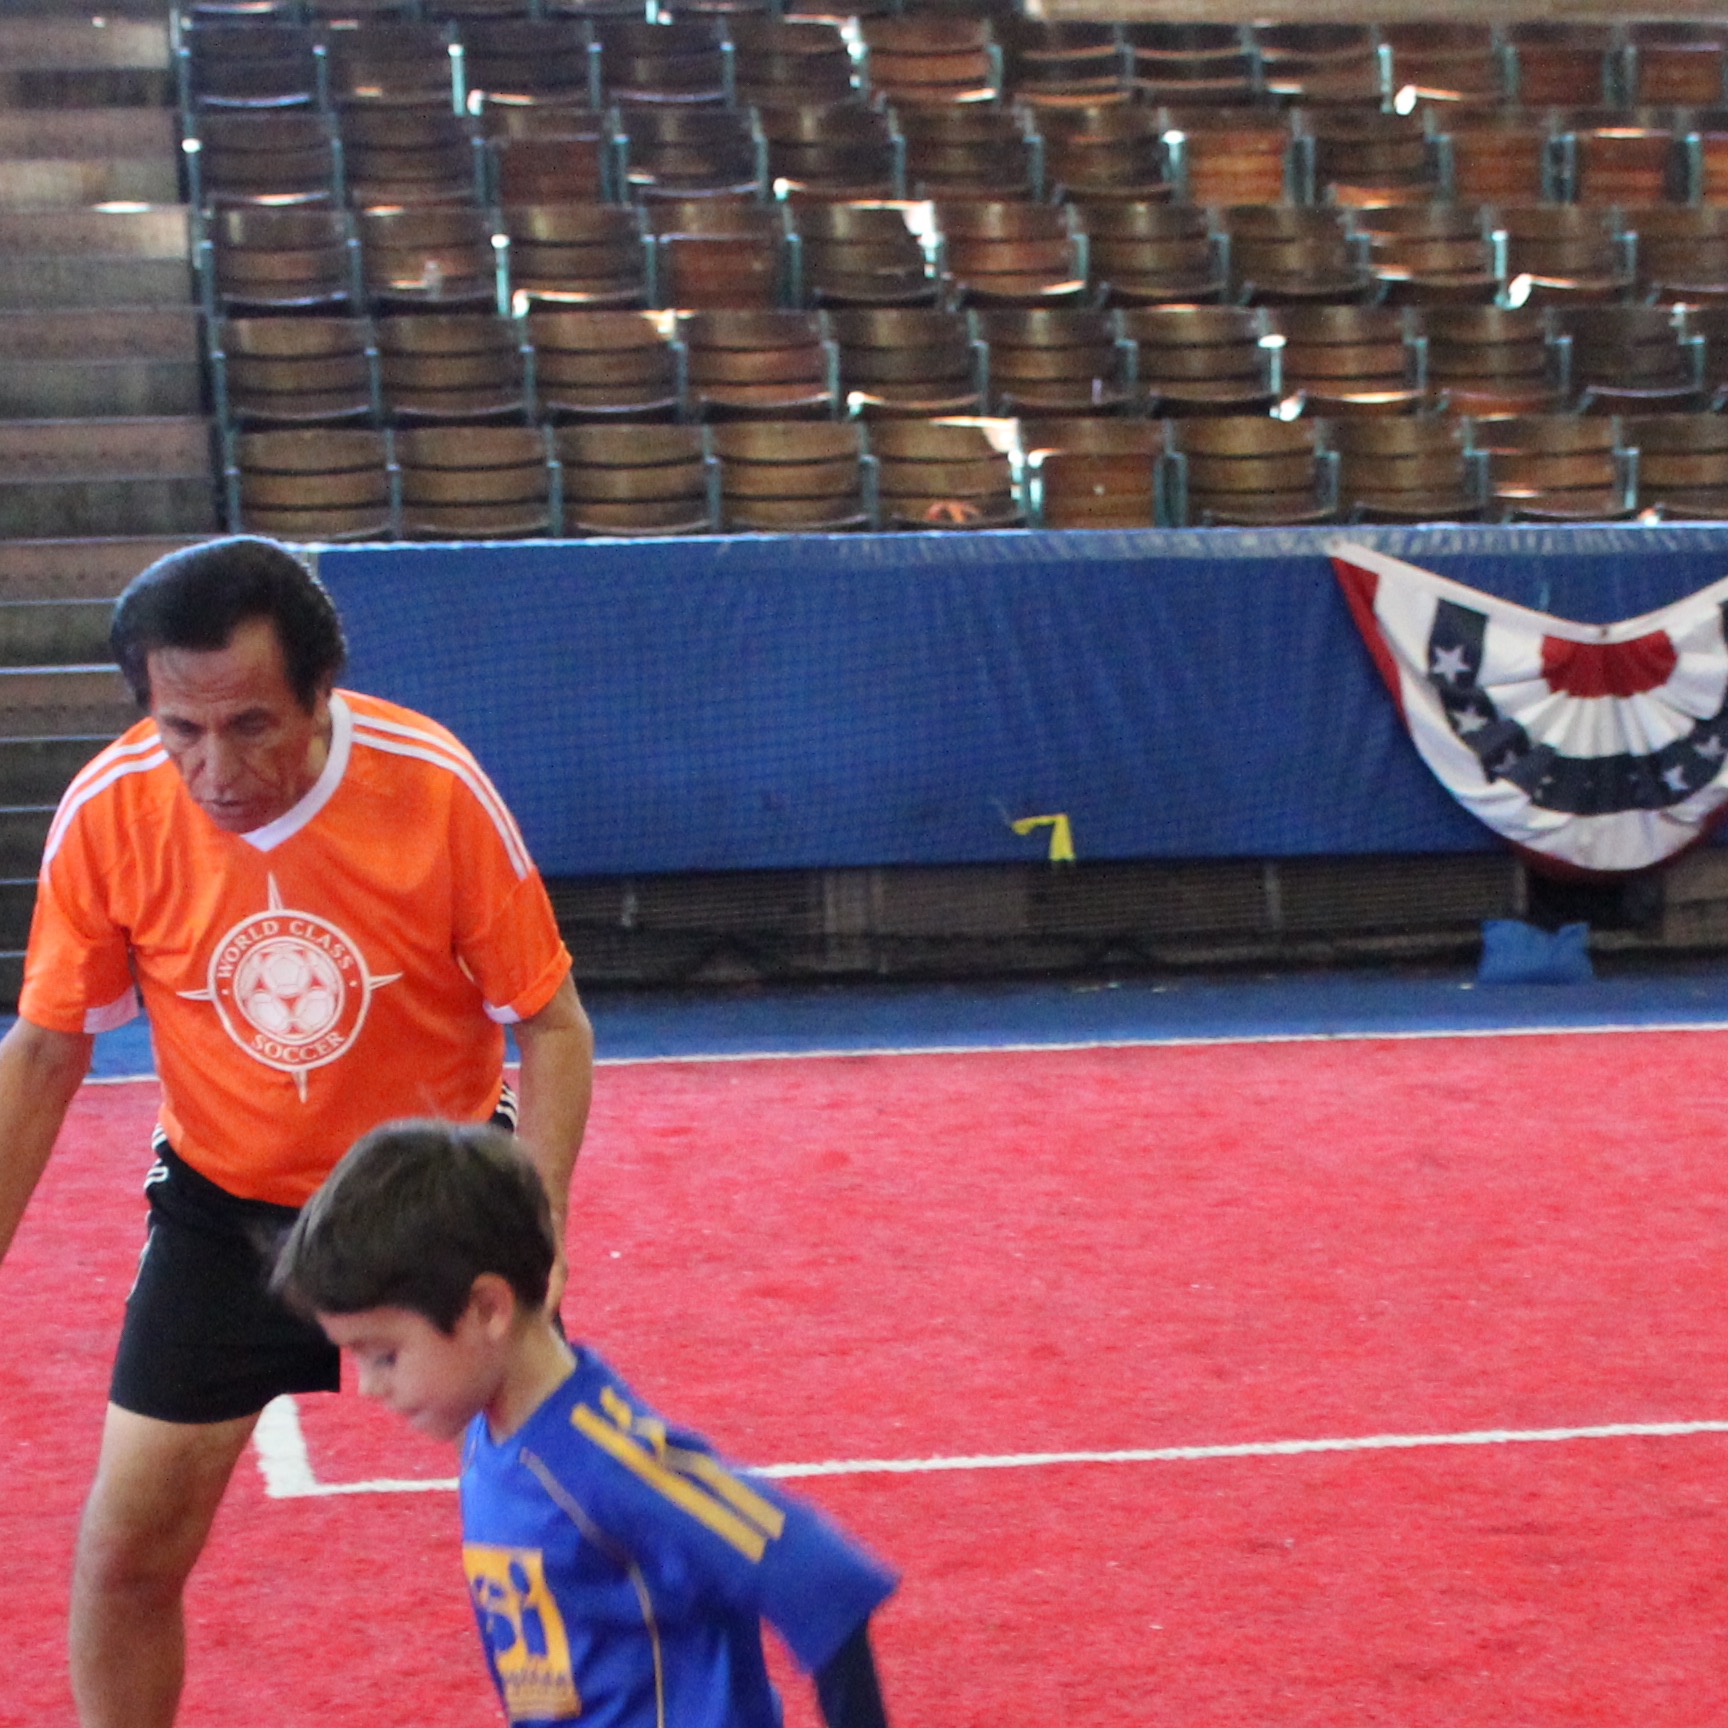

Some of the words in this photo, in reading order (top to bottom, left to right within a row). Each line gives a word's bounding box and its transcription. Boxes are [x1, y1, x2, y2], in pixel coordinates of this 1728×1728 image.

[217, 921, 279, 978] WORLD
[289, 920, 354, 970] CLASS
[251, 1031, 345, 1063] SOCCER
